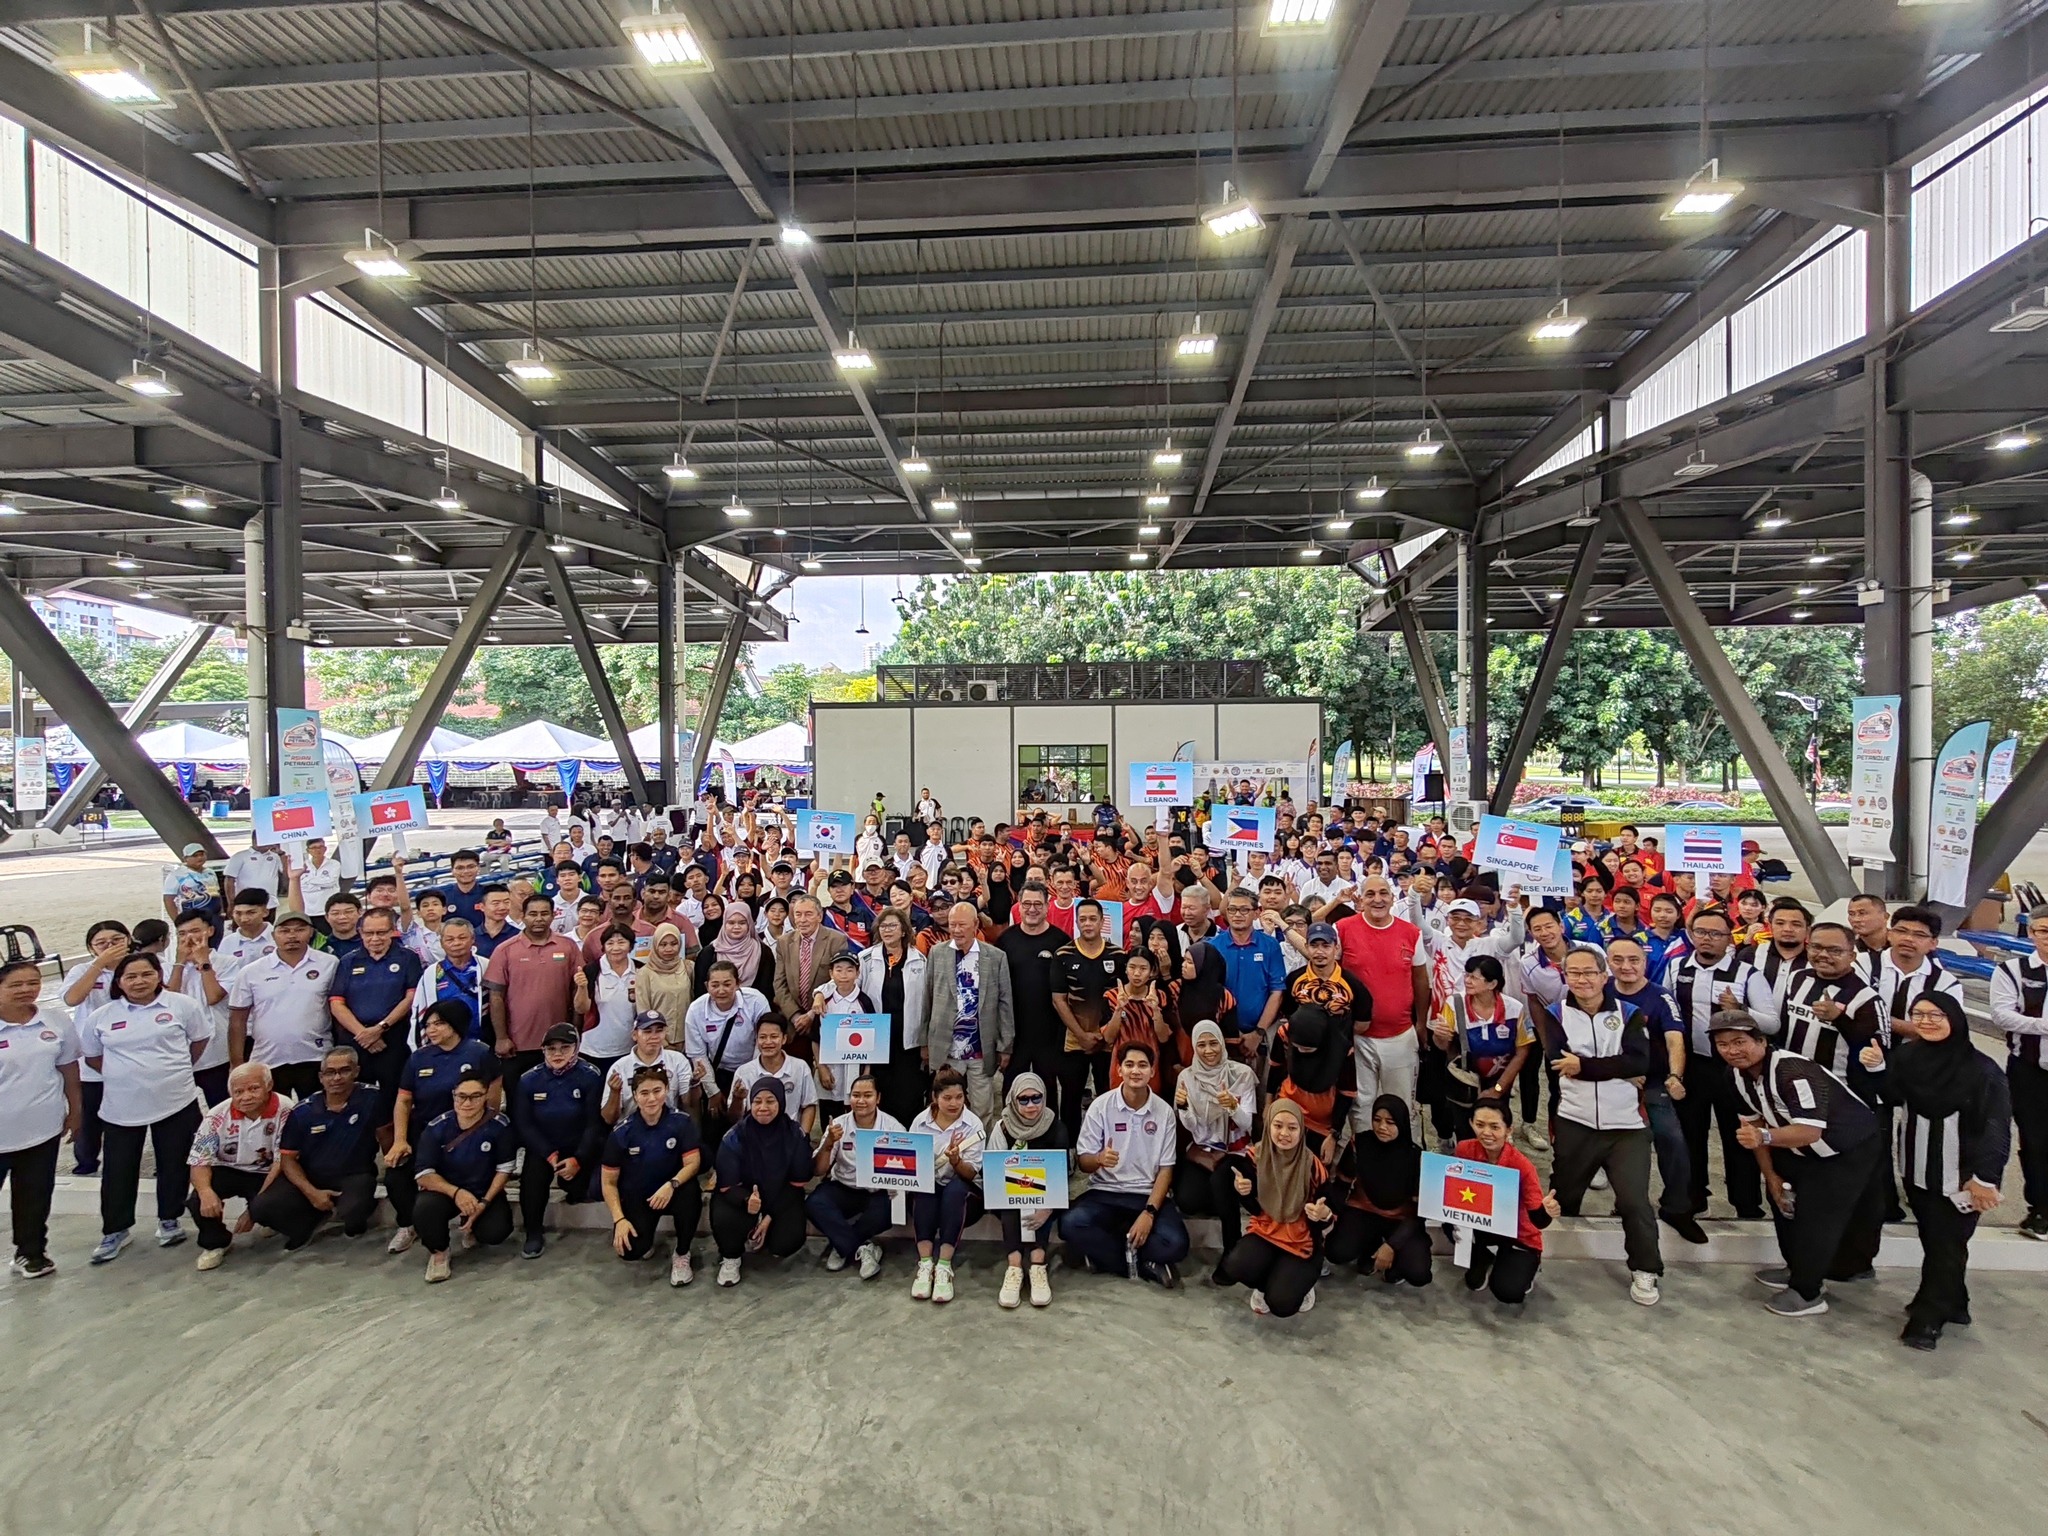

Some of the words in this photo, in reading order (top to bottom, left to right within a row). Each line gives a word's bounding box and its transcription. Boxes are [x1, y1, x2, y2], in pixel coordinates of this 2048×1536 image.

[369, 826, 393, 834] HONG
[395, 821, 418, 830] KONG
[281, 831, 308, 839] CHINA
[1220, 840, 1264, 848] PHILIPPINES
[1486, 856, 1539, 872] SINGAPORE
[872, 1176, 919, 1187] CAMBODIA
[1443, 1209, 1492, 1227] VIETNAM
